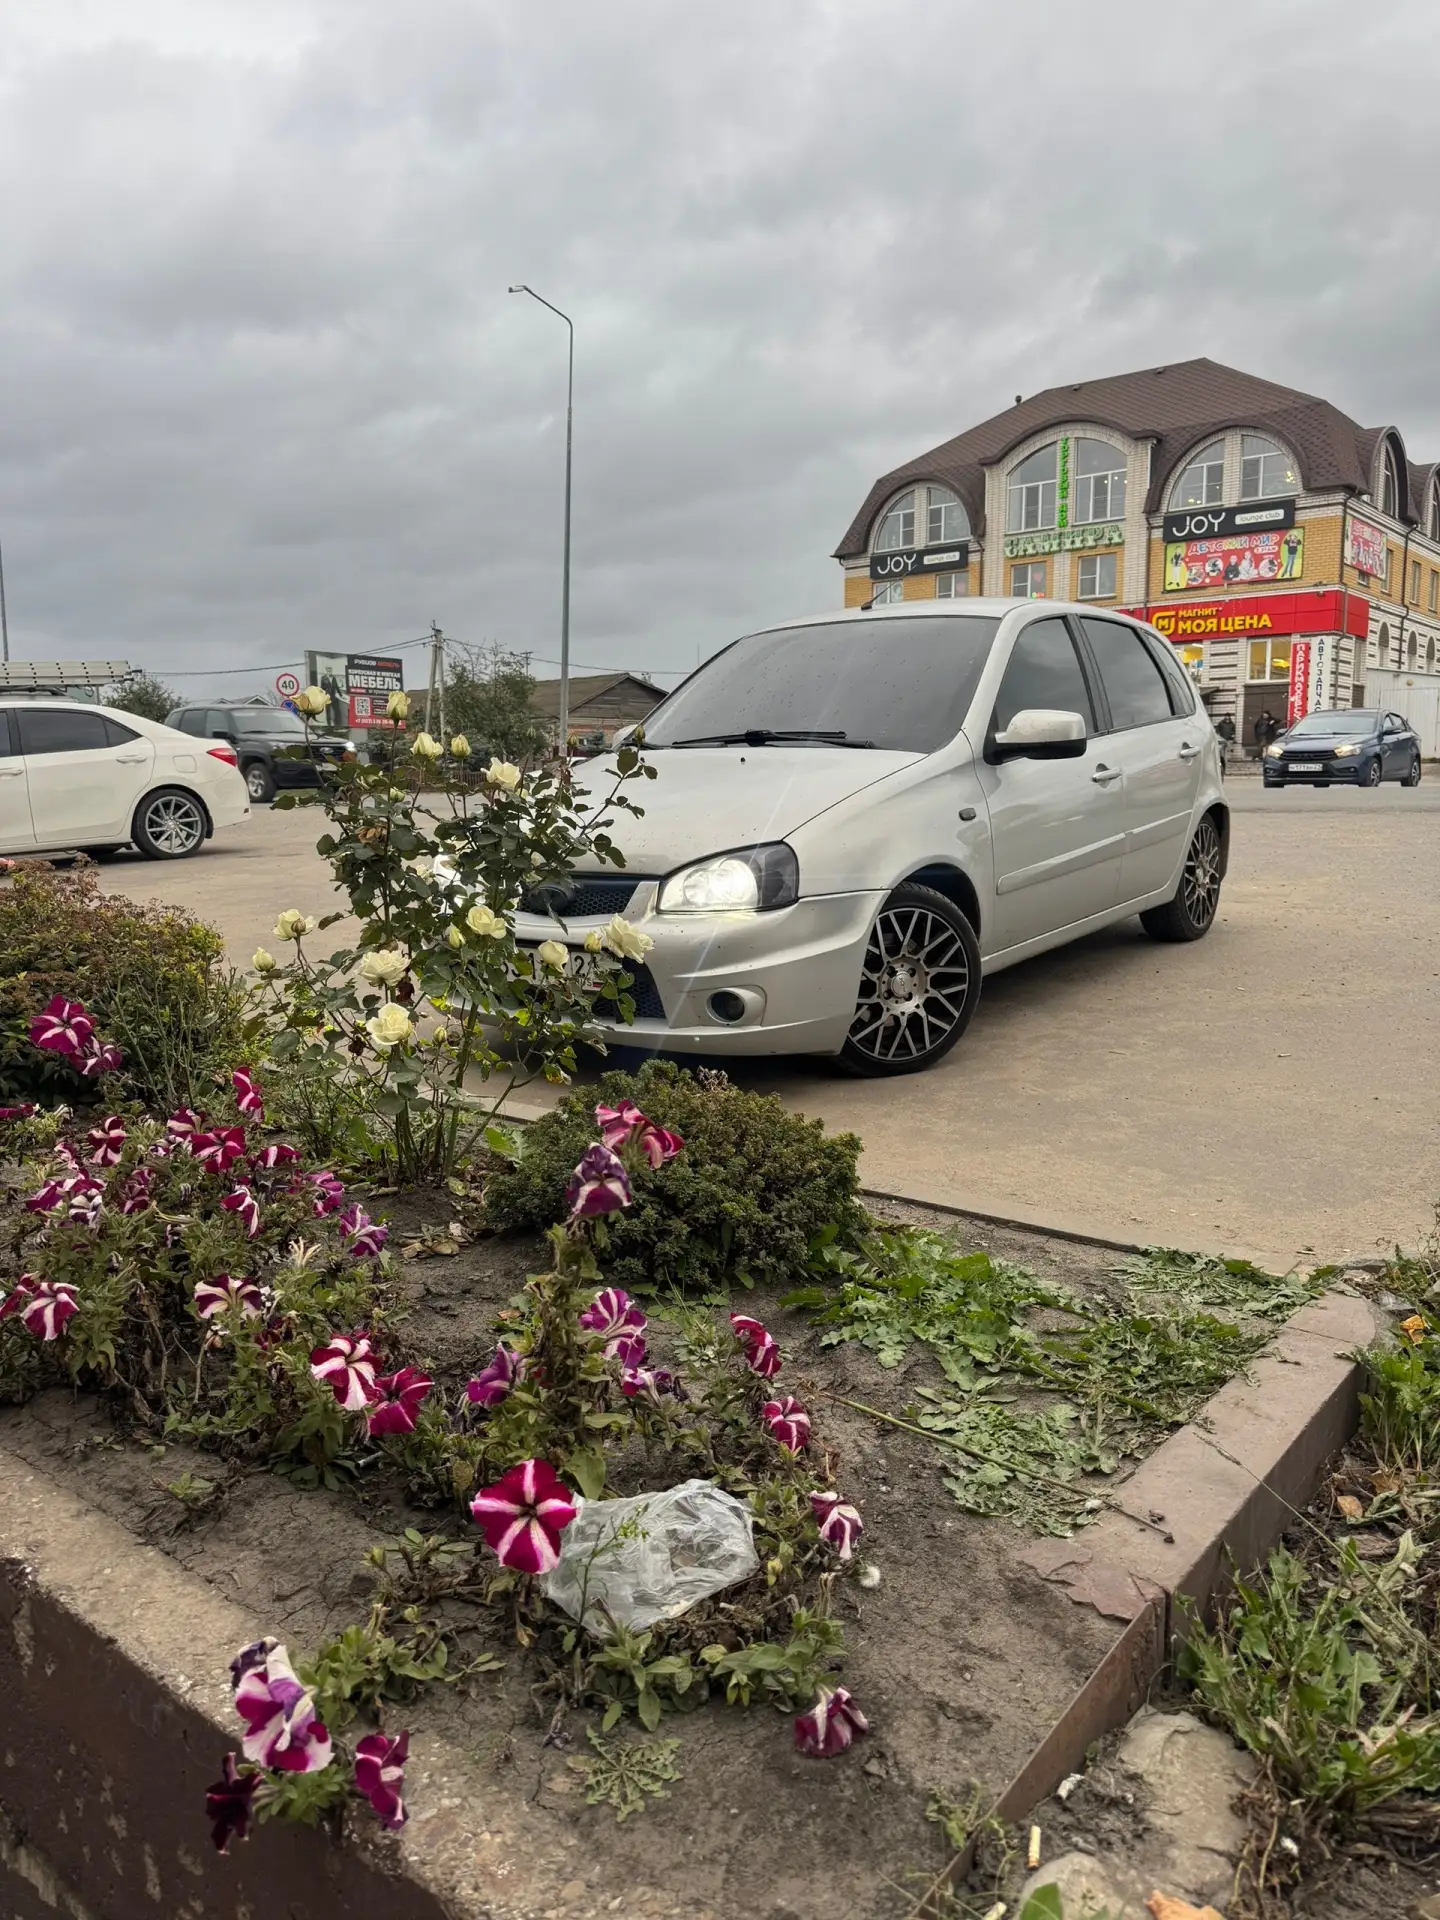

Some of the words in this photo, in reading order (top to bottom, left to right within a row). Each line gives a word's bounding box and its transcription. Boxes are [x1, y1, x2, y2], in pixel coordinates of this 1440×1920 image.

[1172, 512, 1226, 537] JOY
[1239, 514, 1264, 522] lounge
[1264, 511, 1280, 519] club
[1187, 536, 1250, 556] ДЕТСКИЙ
[1250, 533, 1280, 548] МИР
[877, 553, 917, 575] JOY
[1178, 607, 1218, 618] МАГНИТ
[1178, 618, 1217, 634] МОЯ
[1220, 614, 1272, 633] ЦЕНА
[281, 680, 295, 690] 40
[348, 674, 401, 690] МЕБЕЛЬ
